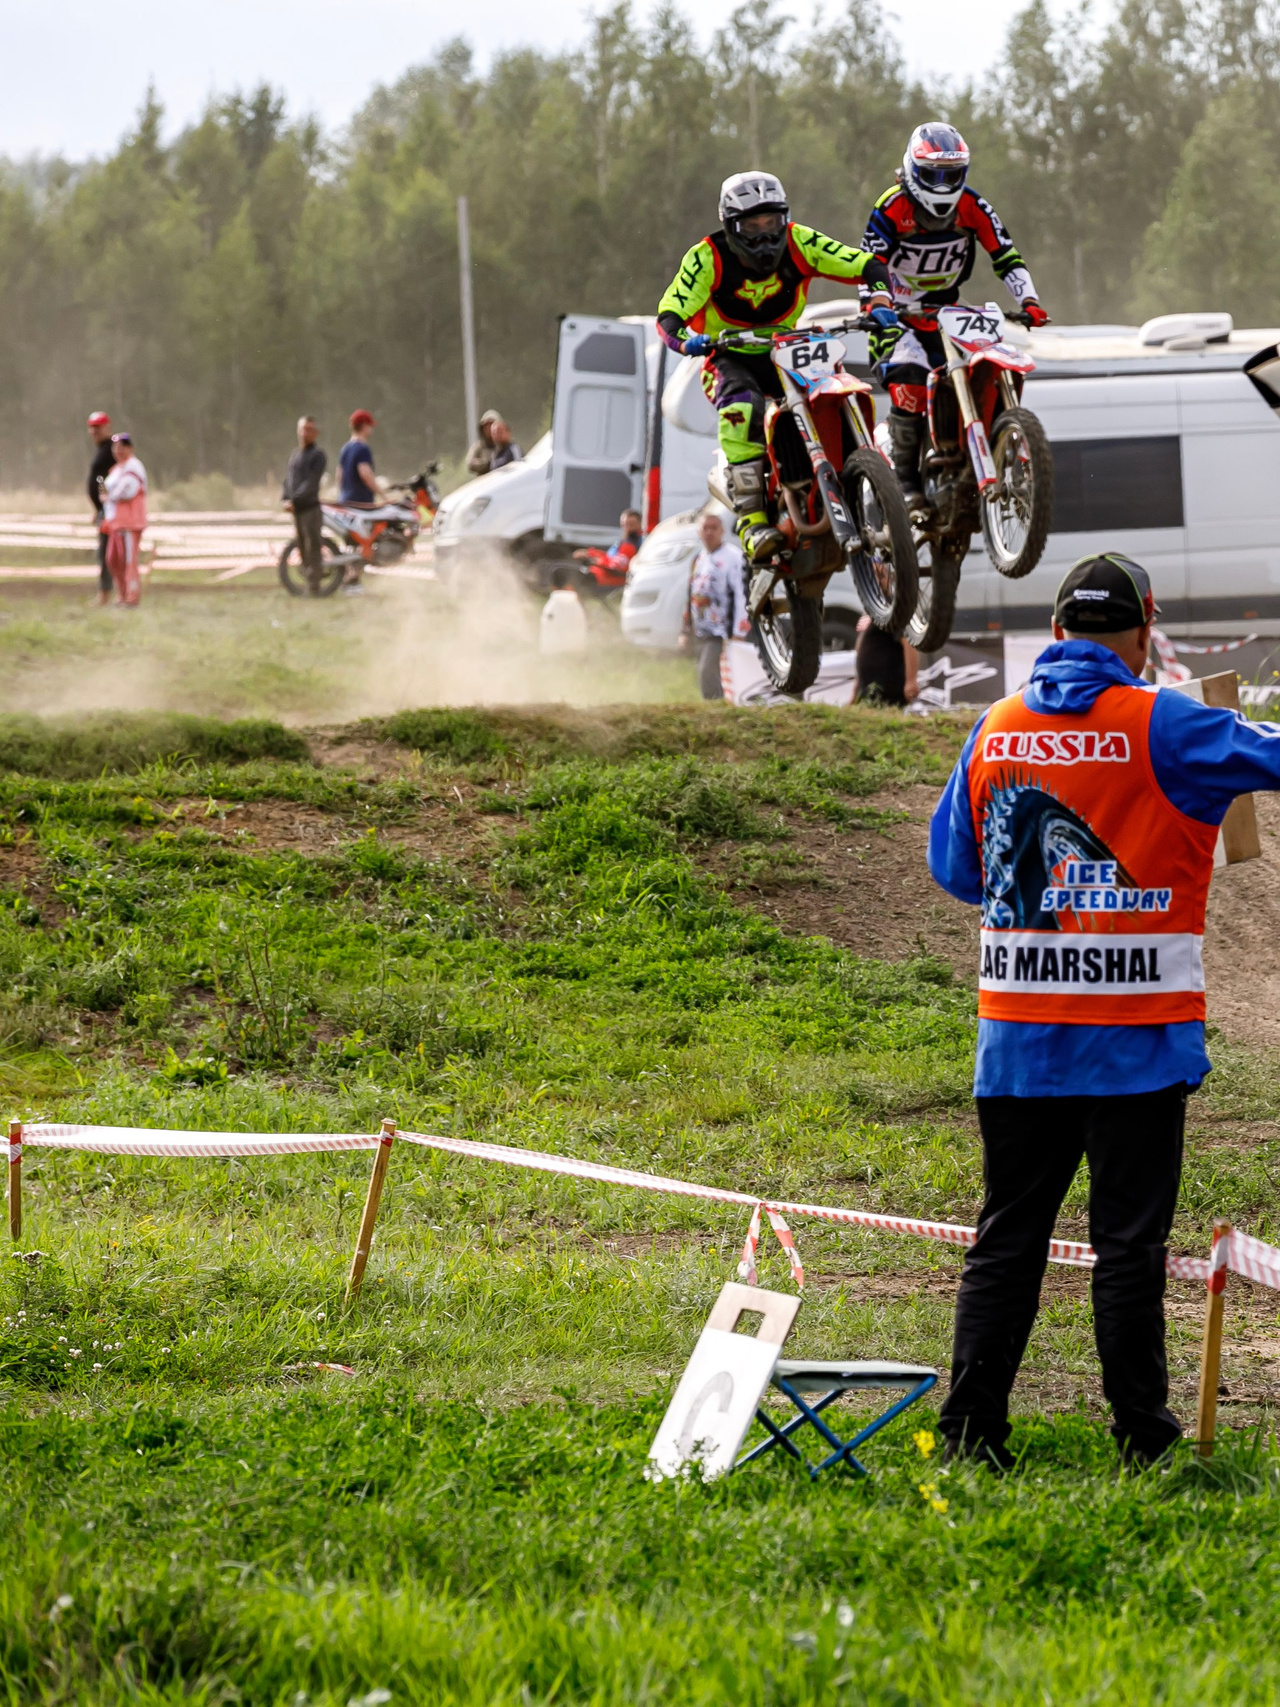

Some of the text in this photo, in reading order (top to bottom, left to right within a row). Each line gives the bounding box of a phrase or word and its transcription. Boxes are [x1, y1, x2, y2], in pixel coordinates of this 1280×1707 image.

[803, 230, 860, 263] FOX
[892, 242, 967, 274] FOX
[671, 252, 704, 308] FOX
[791, 341, 829, 369] 64
[983, 731, 1131, 766] RUSSIA
[1065, 861, 1118, 886] ICE
[1041, 888, 1172, 912] SPEEDWAY
[980, 945, 1161, 983] AG MARSHAL
